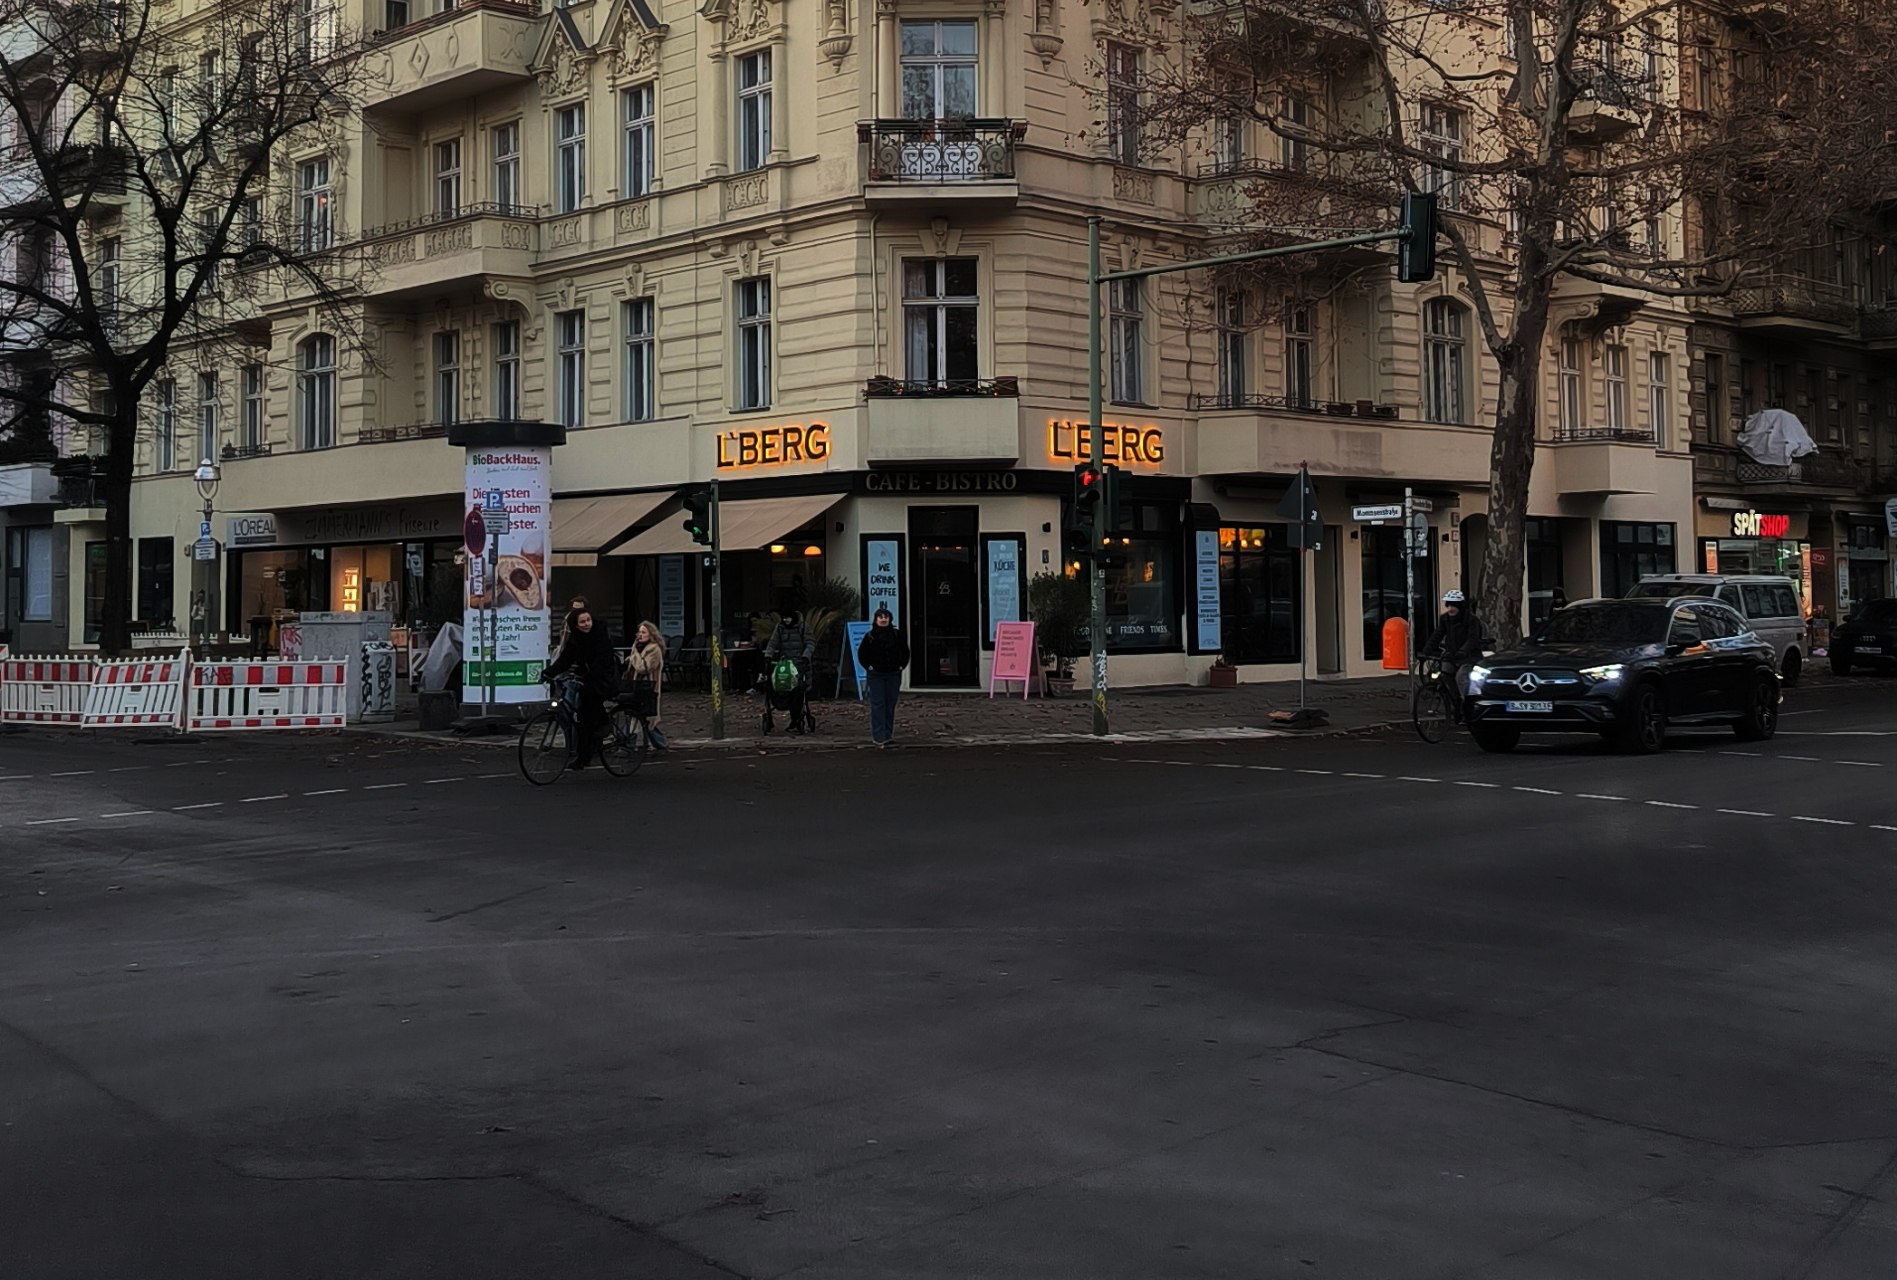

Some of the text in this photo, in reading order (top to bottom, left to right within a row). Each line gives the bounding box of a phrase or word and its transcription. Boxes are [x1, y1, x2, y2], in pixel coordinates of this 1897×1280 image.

[935, 472, 1017, 490] BISTRO
[878, 563, 890, 572] WE
[871, 575, 895, 584] DRINK
[870, 587, 896, 596] COFFEE
[880, 601, 888, 610] IN
[1120, 625, 1145, 634] FRIENDS
